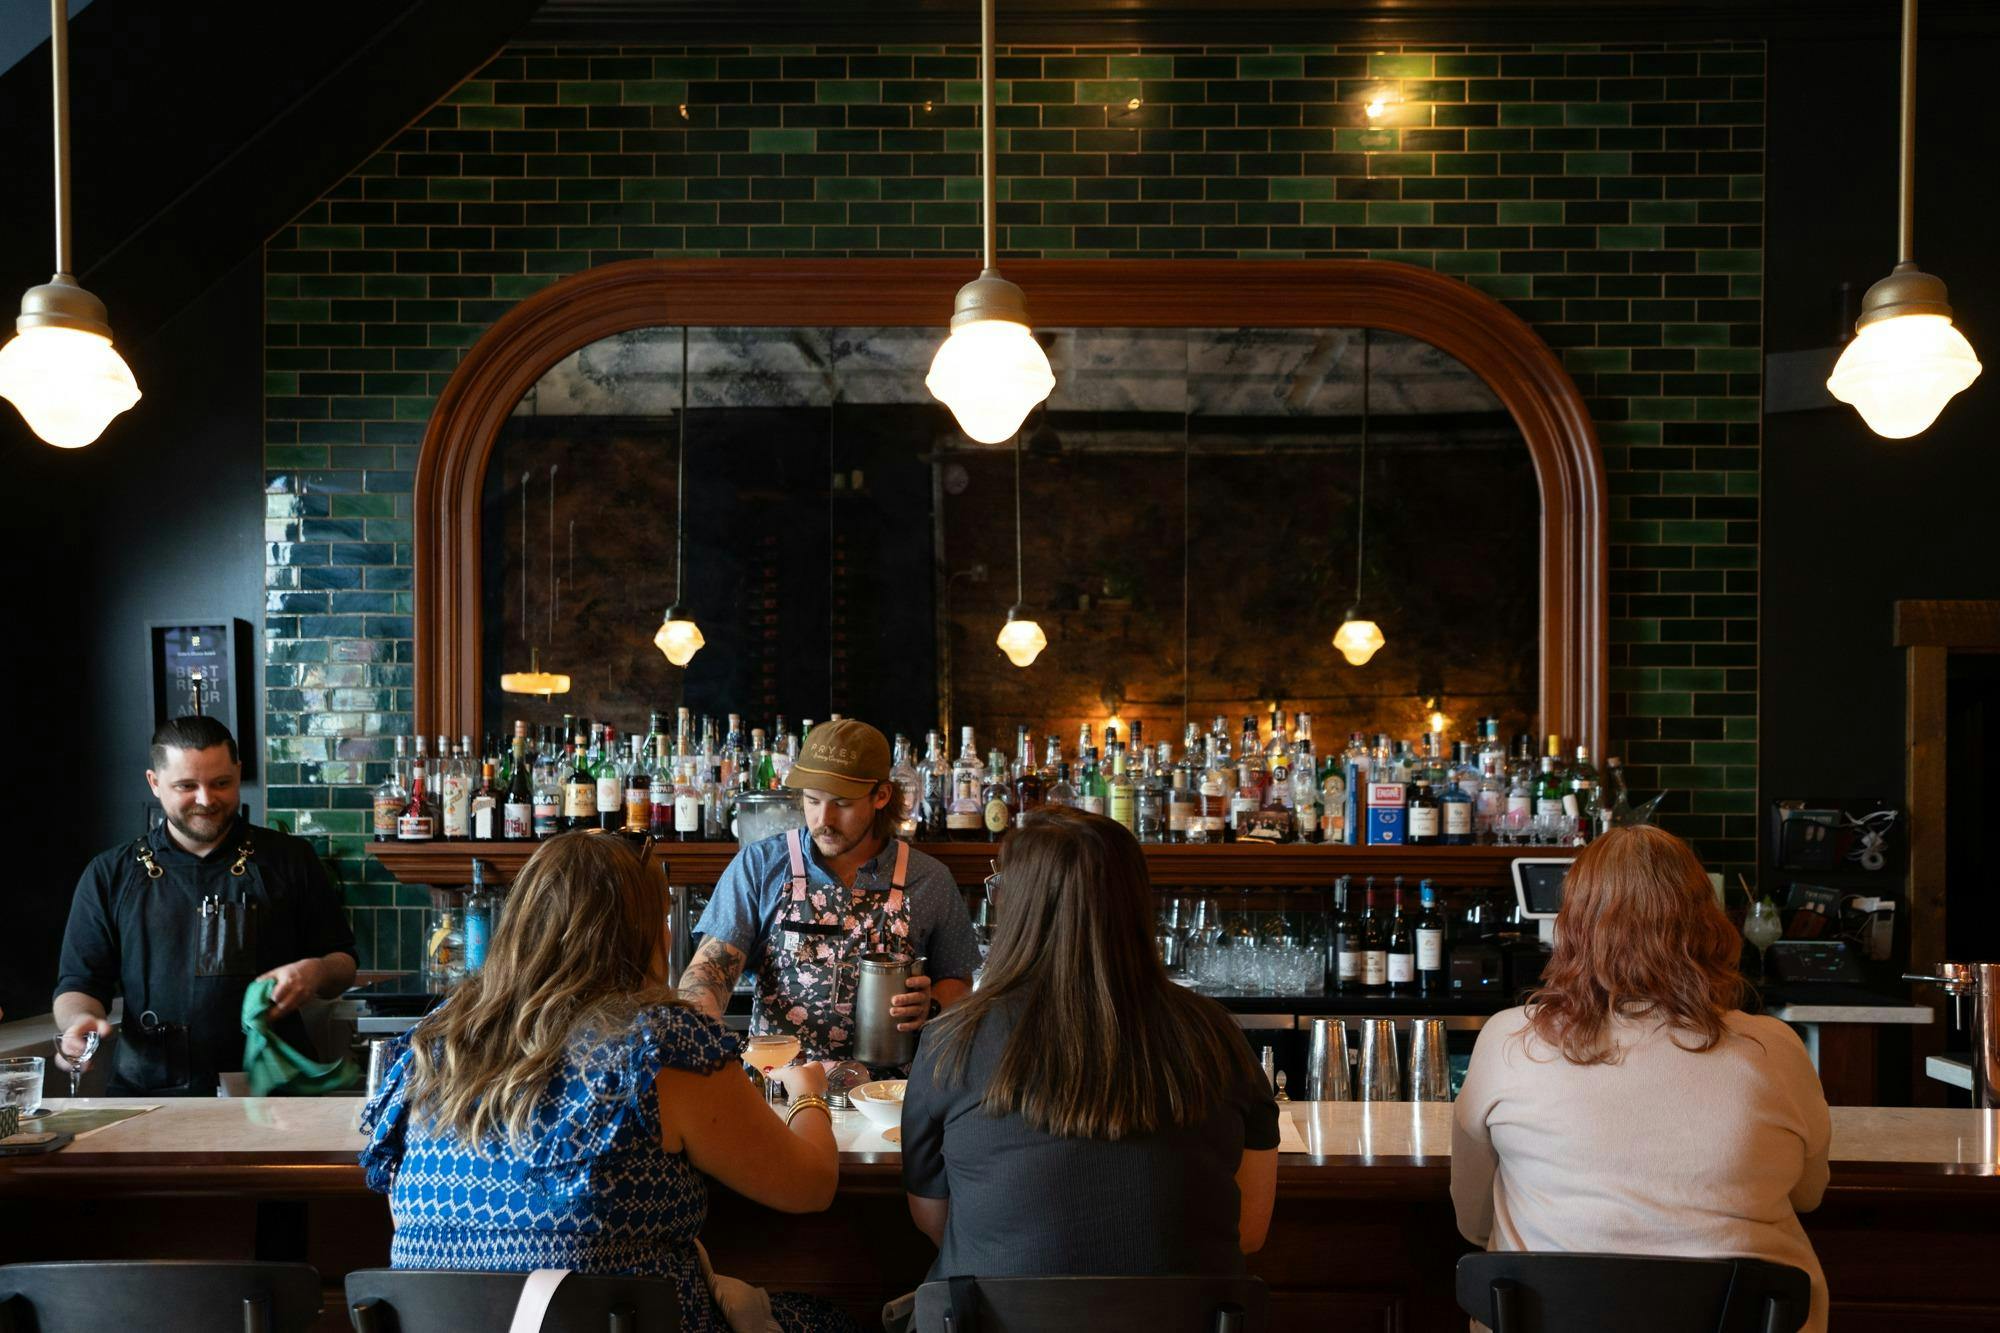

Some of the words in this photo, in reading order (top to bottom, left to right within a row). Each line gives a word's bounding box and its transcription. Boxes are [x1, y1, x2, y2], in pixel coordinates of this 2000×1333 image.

[176, 665, 218, 678] BEST
[176, 678, 218, 691] REST
[811, 743, 857, 760] PRYES
